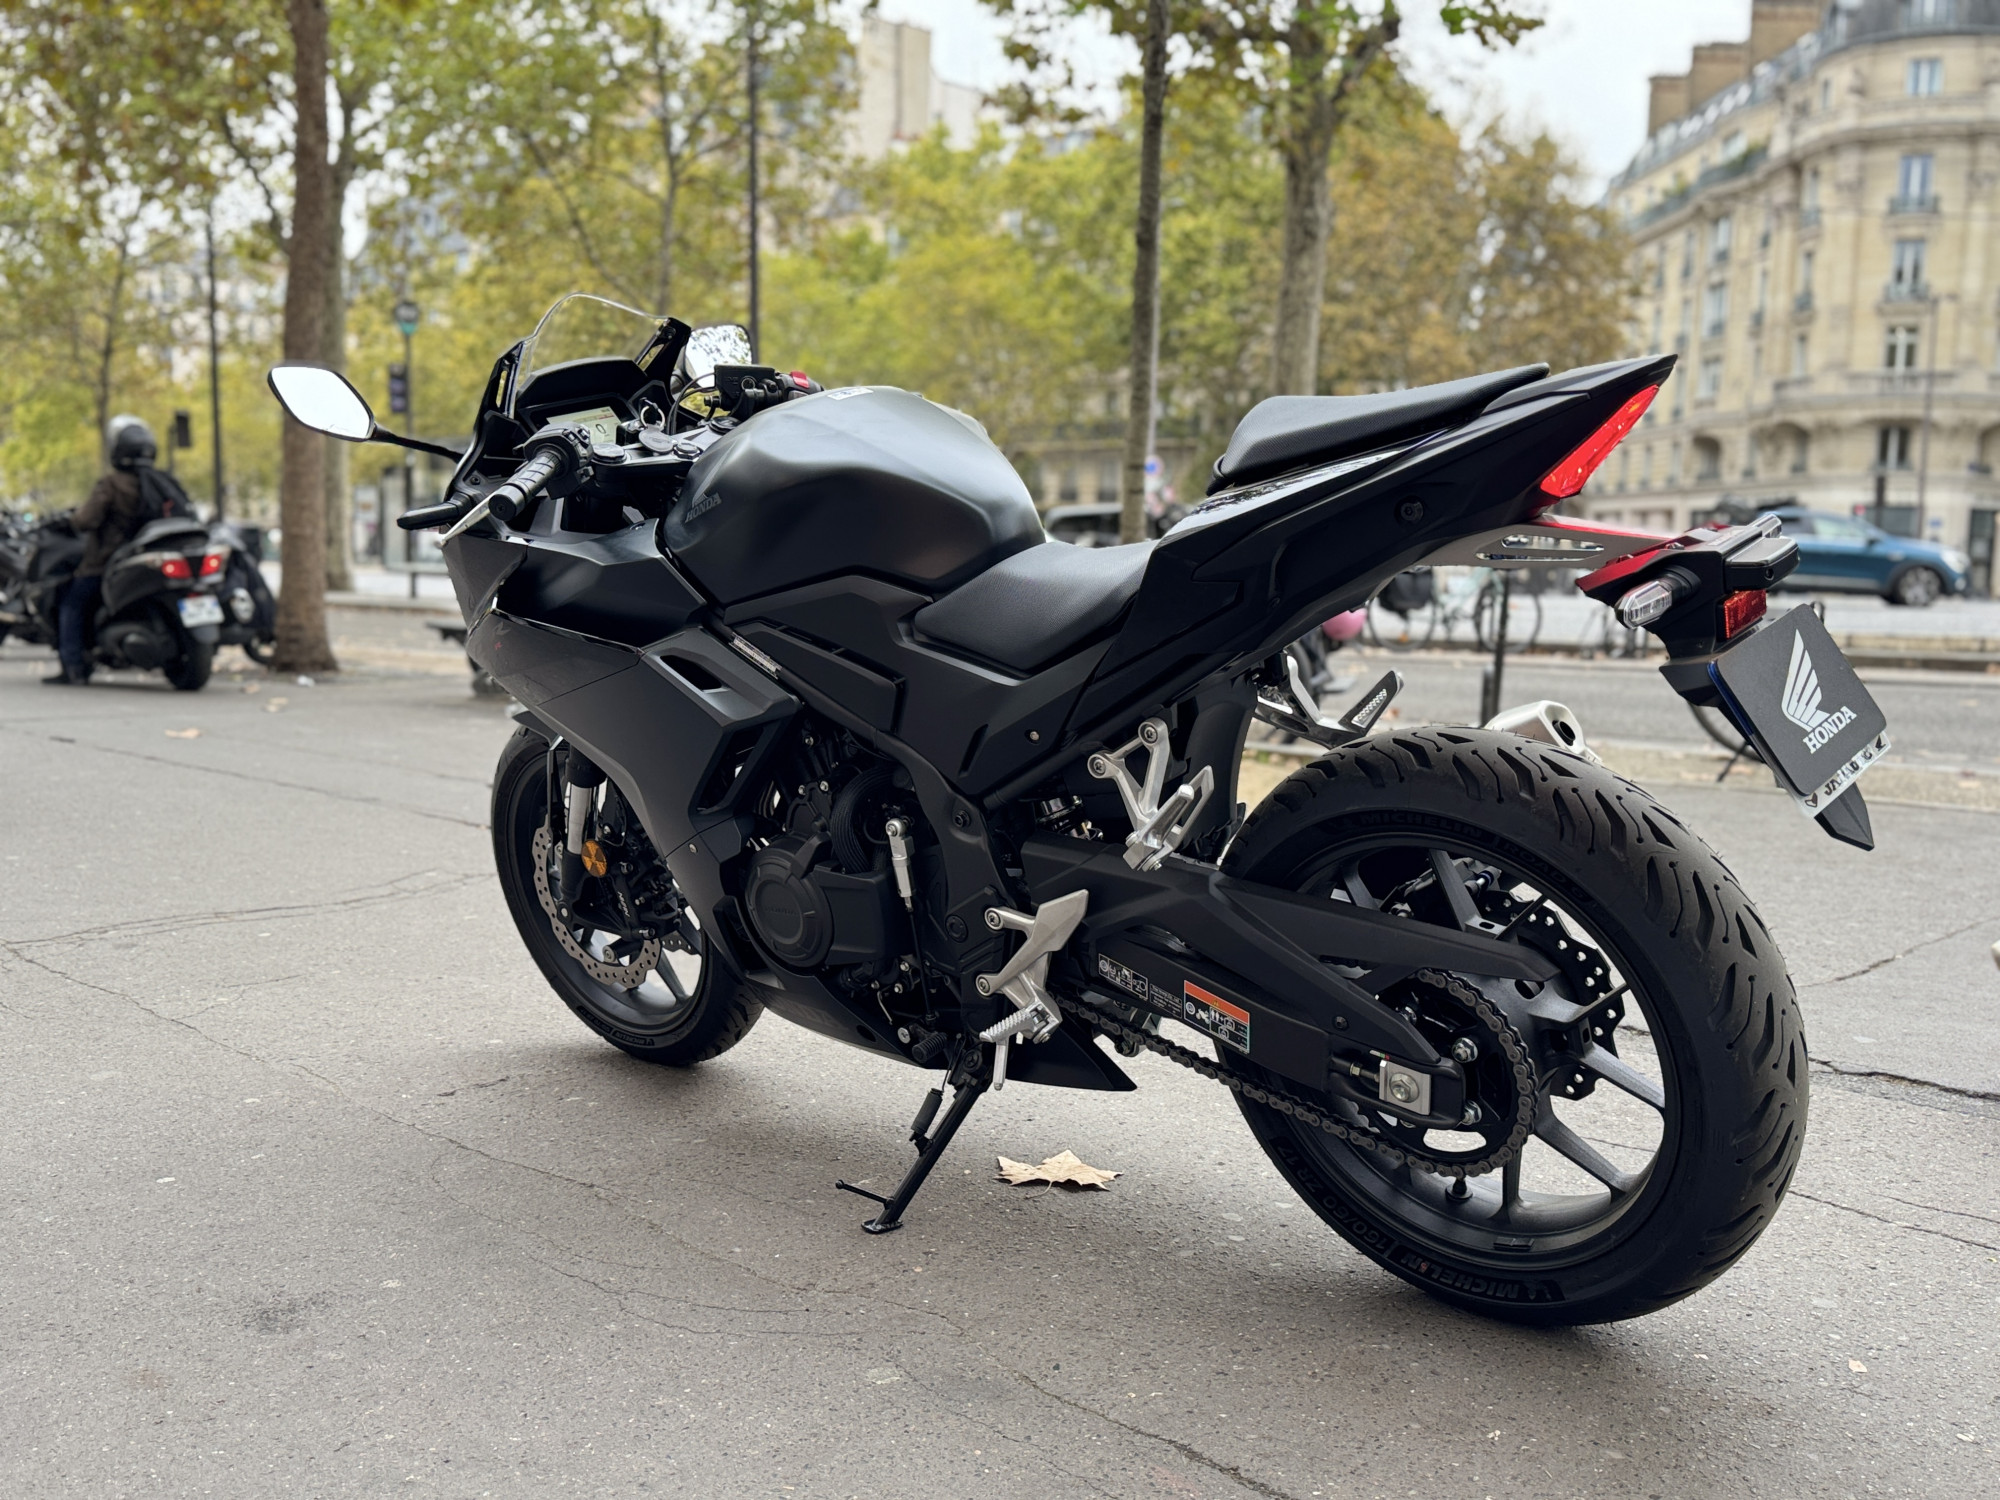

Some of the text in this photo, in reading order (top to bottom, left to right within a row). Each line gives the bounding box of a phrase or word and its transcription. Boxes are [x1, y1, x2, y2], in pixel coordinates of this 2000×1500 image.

[684, 492, 722, 523] HONDA
[1803, 705, 1857, 755] HONDA
[1359, 811, 1483, 838] MICHELIN
[1502, 840, 1566, 882] ROAD
[1277, 1144, 1301, 1166] 17
[1296, 1166, 1324, 1193] ZR
[1402, 1253, 1519, 1298] MICHELIN
